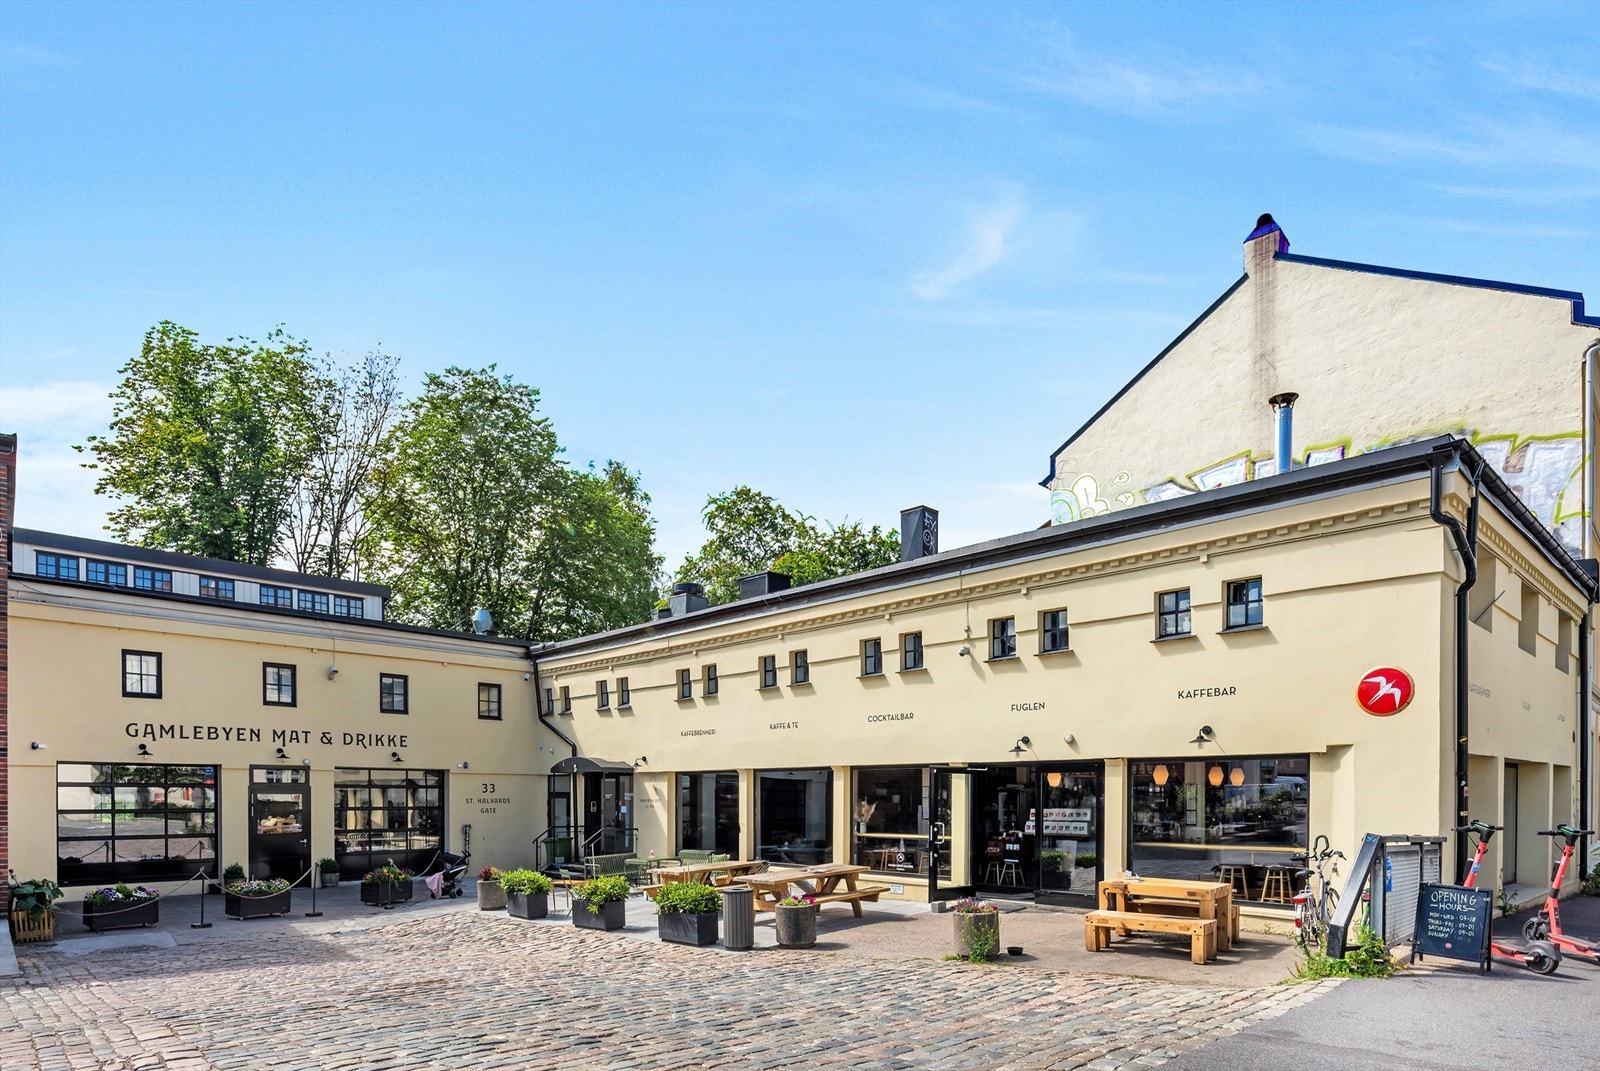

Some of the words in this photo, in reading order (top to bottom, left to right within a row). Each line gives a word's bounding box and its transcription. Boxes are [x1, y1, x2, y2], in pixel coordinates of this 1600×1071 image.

[1177, 686, 1237, 699] KAFFEBAR
[1011, 702, 1045, 712] FUGLEN
[867, 712, 914, 722] COCKTAILBAR
[769, 722, 785, 730] KAFFE
[792, 721, 799, 729] TE
[125, 722, 261, 742] GAMLEBYEN
[272, 729, 311, 747] MAT
[320, 732, 333, 745] &
[342, 732, 408, 749] DRIKKE
[680, 729, 716, 737] KAFFEBRENNERI
[481, 783, 496, 793] 33
[1431, 891, 1476, 905] OPENING
[1428, 924, 1454, 934] SATURDAY
